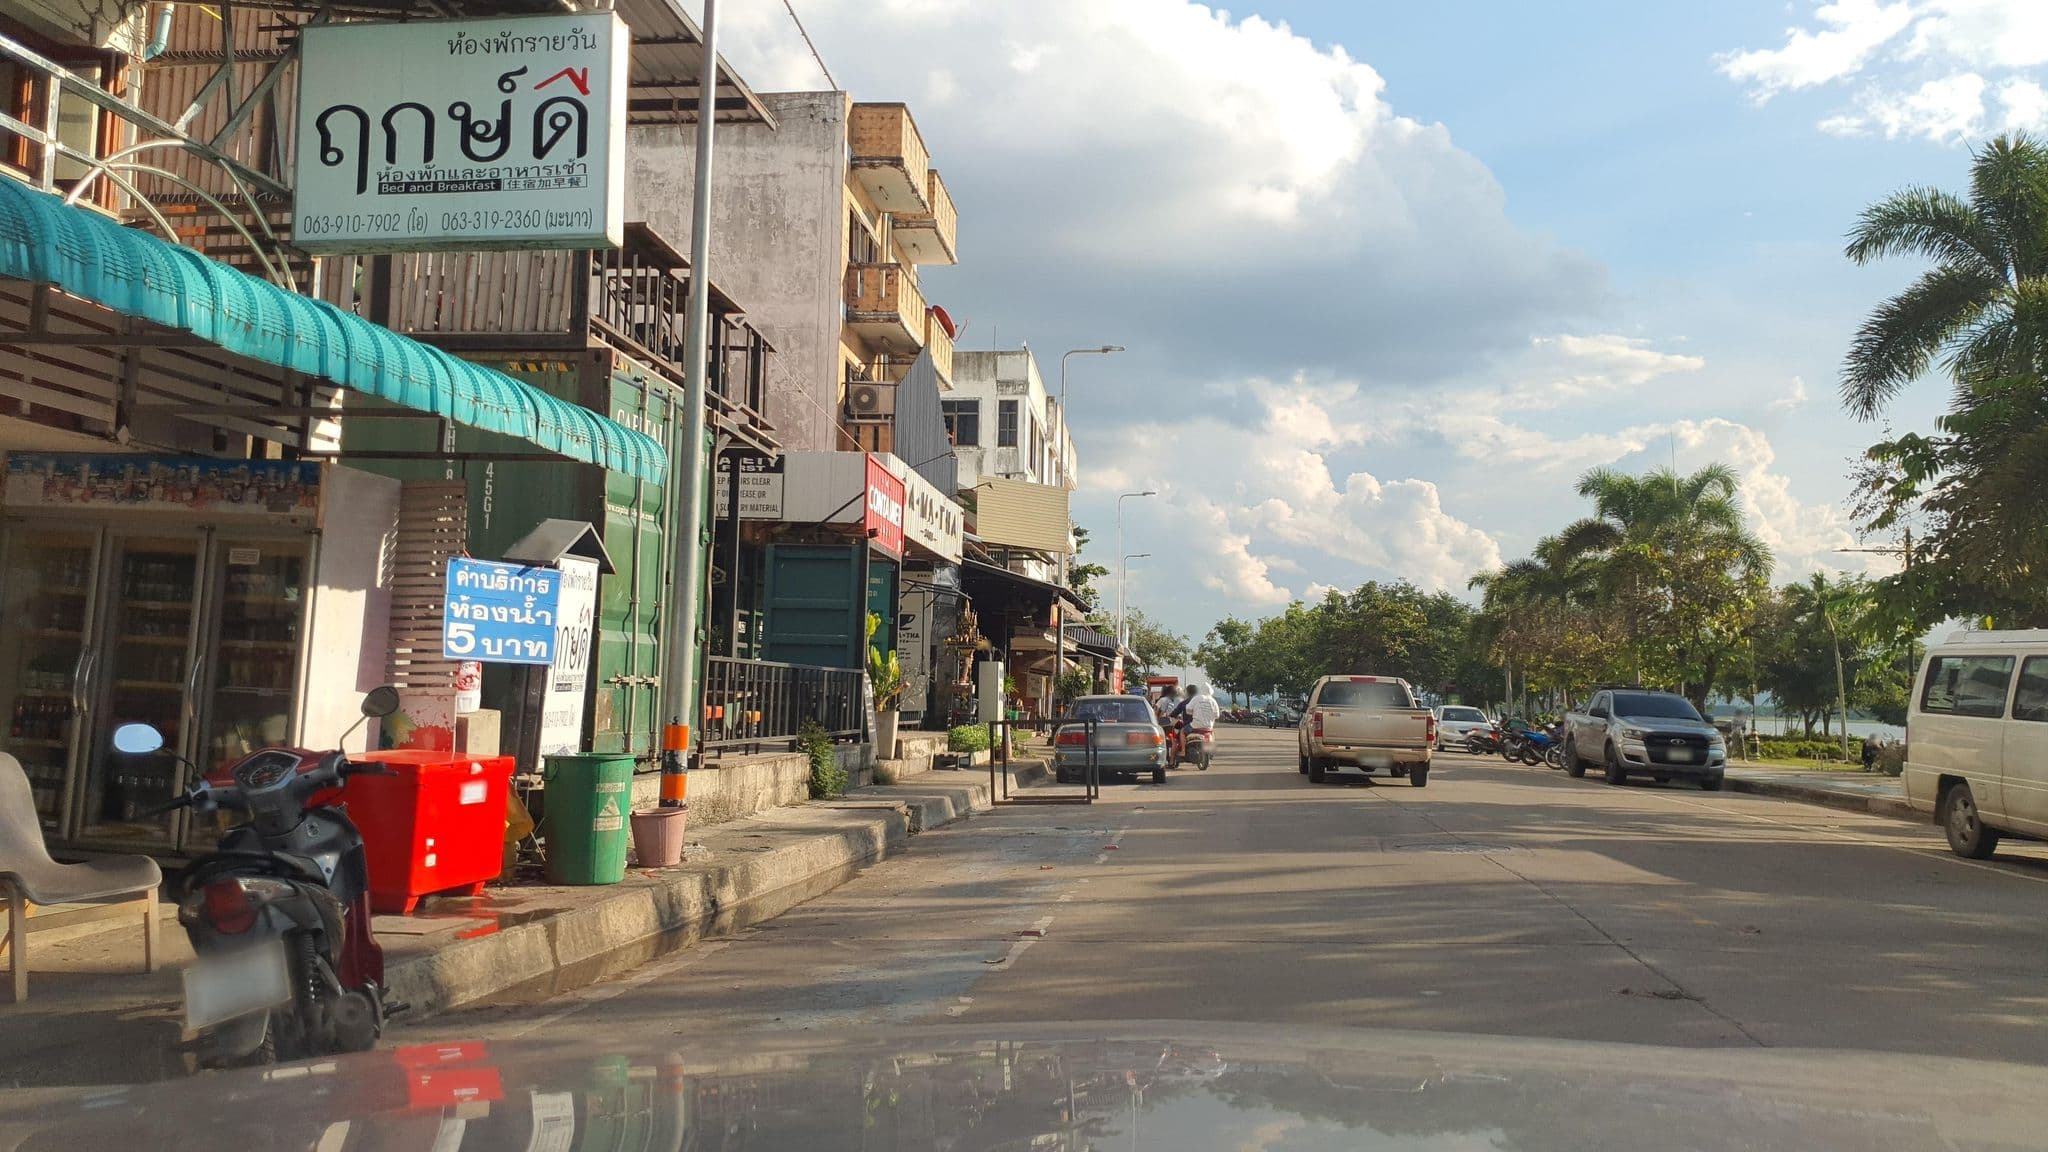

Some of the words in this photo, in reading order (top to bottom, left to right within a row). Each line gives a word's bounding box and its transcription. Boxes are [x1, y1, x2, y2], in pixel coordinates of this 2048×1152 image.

[447, 27, 597, 56] ห้องพักรายวัน
[315, 65, 590, 195] ฤกษ์ดี
[377, 158, 587, 182] ห้องพักและอาหารเช้า
[506, 177, 582, 190] 住宿加早餐
[381, 183, 405, 193] Bed
[410, 182, 433, 192] and
[437, 180, 496, 192] Breakfast
[304, 213, 400, 234] 063-910-7902
[441, 209, 541, 231] 063-319-2360
[545, 207, 593, 230] (มะนาว)
[483, 461, 495, 530] 45G1
[752, 477, 771, 486] CLEAR
[749, 503, 779, 513] MATERIAL
[456, 565, 550, 595] ค่าบริการ
[449, 594, 552, 626] ห้องน้ำ
[446, 621, 476, 654] 5
[481, 637, 548, 658] บาท
